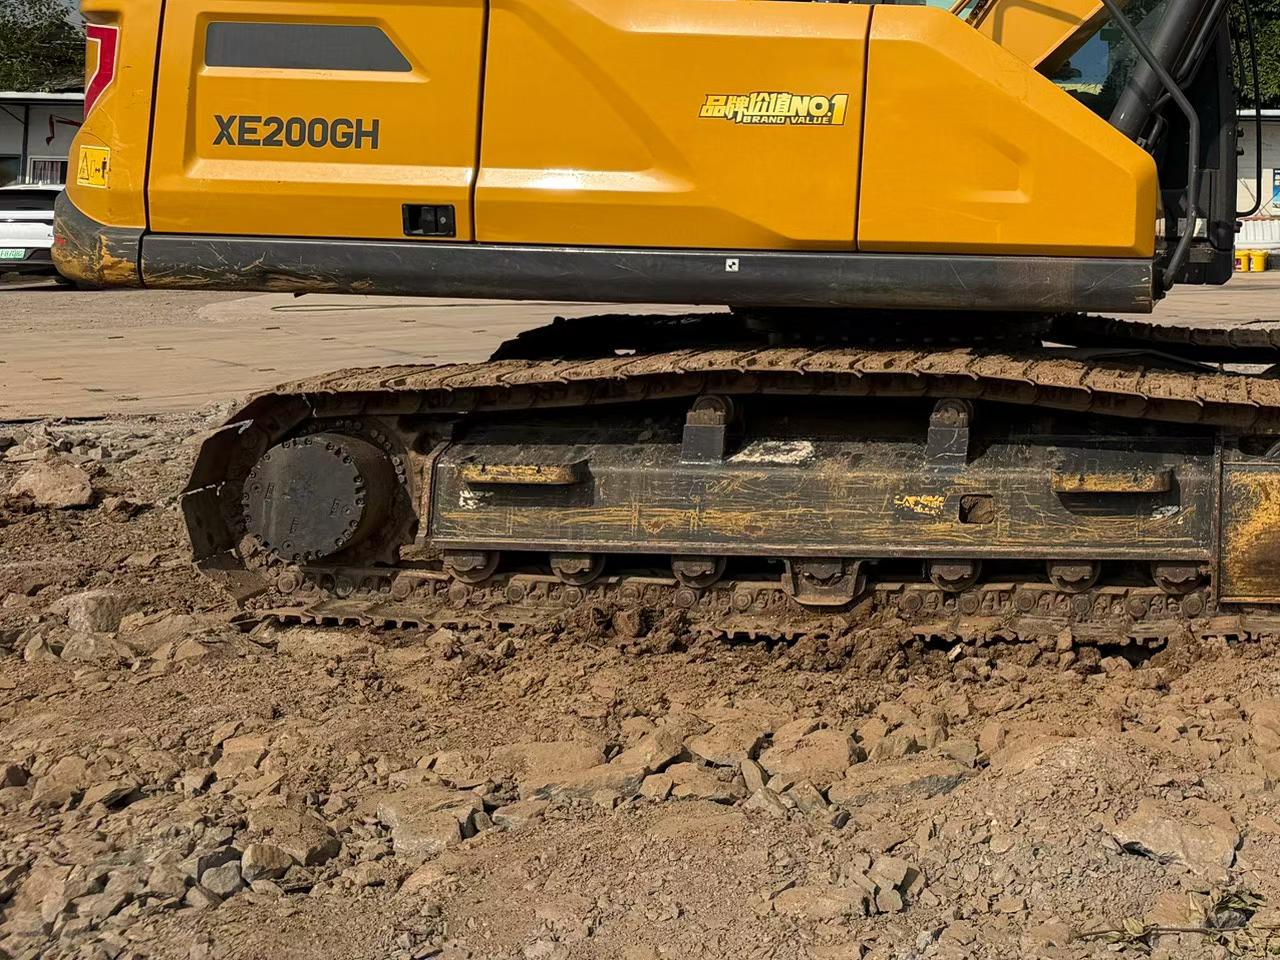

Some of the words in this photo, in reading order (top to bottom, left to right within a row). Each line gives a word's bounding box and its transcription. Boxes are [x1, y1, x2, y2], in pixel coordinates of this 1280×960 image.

[743, 116, 786, 124] BRAND
[791, 116, 830, 125] VALUE
[212, 115, 380, 150] XE200GH
